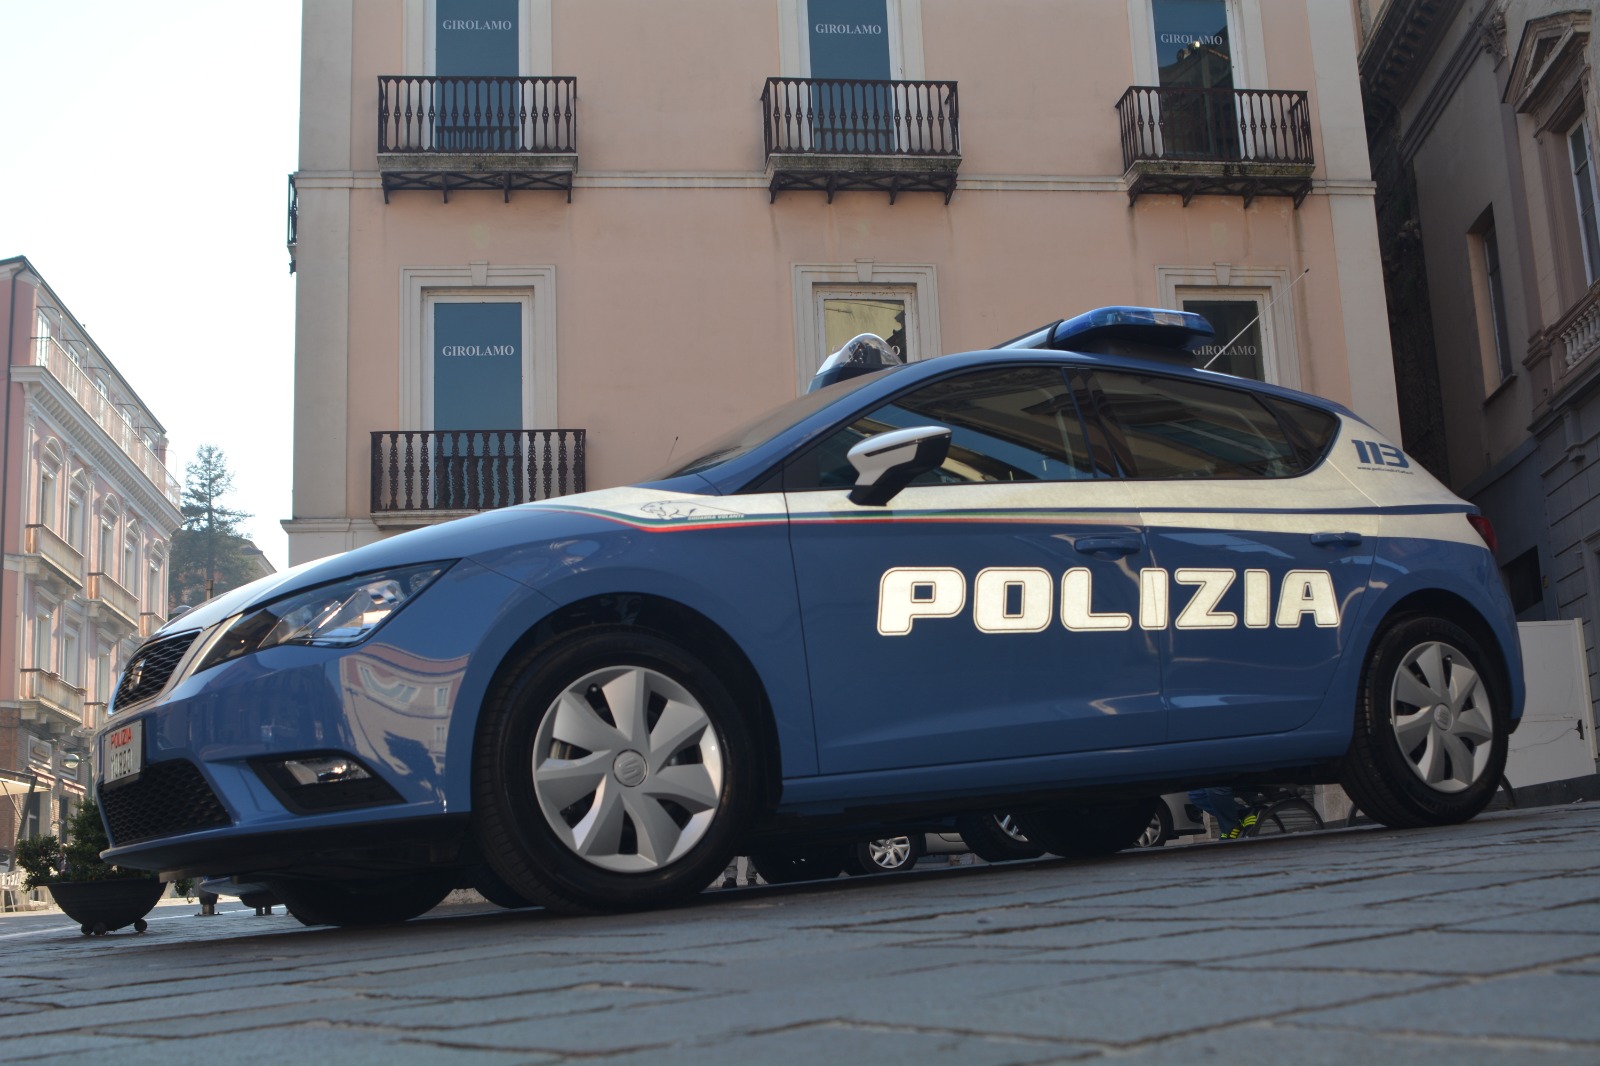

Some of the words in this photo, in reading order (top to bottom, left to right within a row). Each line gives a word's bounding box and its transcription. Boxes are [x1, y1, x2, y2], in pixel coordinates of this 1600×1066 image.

[442, 20, 512, 30] GIROLAMO
[815, 23, 882, 35] GIROLAMO
[1160, 33, 1223, 45] GIROLAMO
[442, 345, 515, 356] GIROLAMO
[1351, 439, 1410, 469] 113
[877, 566, 1341, 636] POLIZIA
[111, 727, 132, 749] POLIZIA
